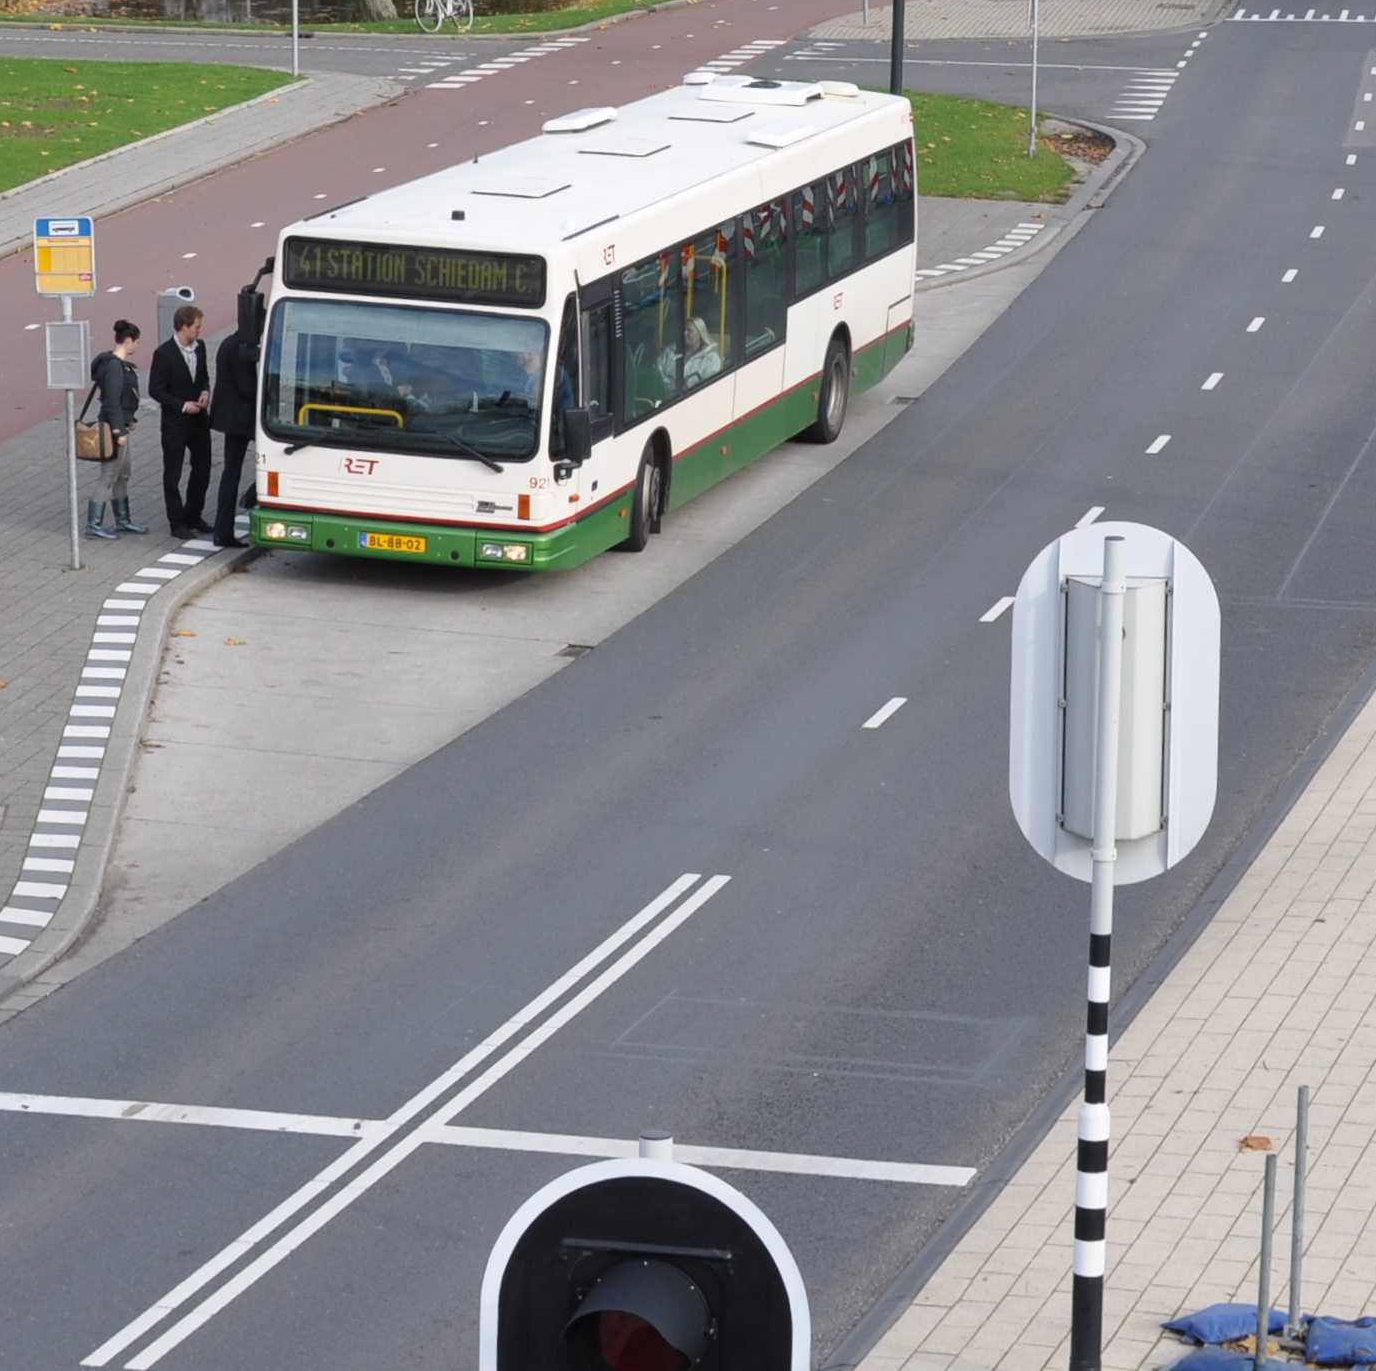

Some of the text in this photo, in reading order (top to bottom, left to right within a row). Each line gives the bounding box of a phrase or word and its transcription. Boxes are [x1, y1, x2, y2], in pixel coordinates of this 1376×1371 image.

[299, 247, 321, 277] 41
[327, 249, 406, 284] STATION
[414, 255, 507, 293] SCHIEDAM
[344, 458, 380, 476] RET
